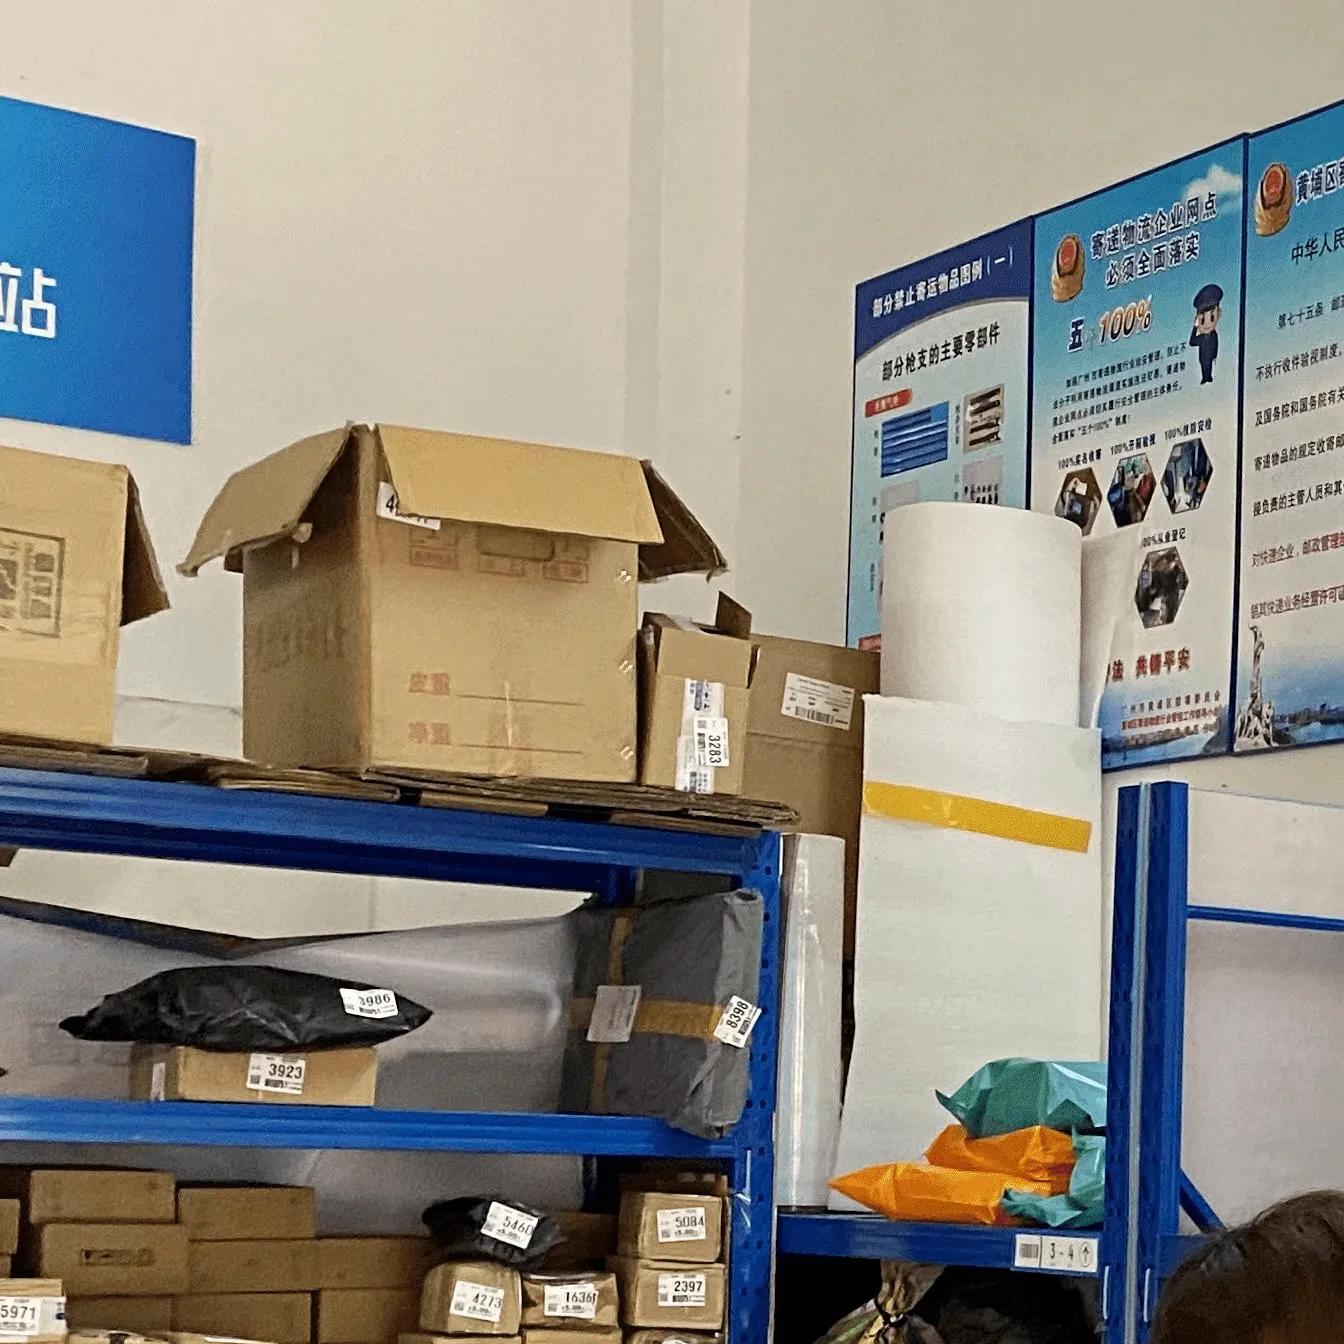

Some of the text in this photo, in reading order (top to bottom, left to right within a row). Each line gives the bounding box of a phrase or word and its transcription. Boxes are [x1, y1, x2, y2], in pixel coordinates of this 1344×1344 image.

[1105, 232, 1199, 288] 必须全面落实
[882, 321, 1000, 380] 部分枪支的主要零部件
[707, 733, 722, 766] 3283
[725, 1000, 748, 1029] 8398
[268, 1062, 303, 1080] 3923
[502, 1214, 533, 1237] 5460
[674, 1280, 703, 1292] 2397
